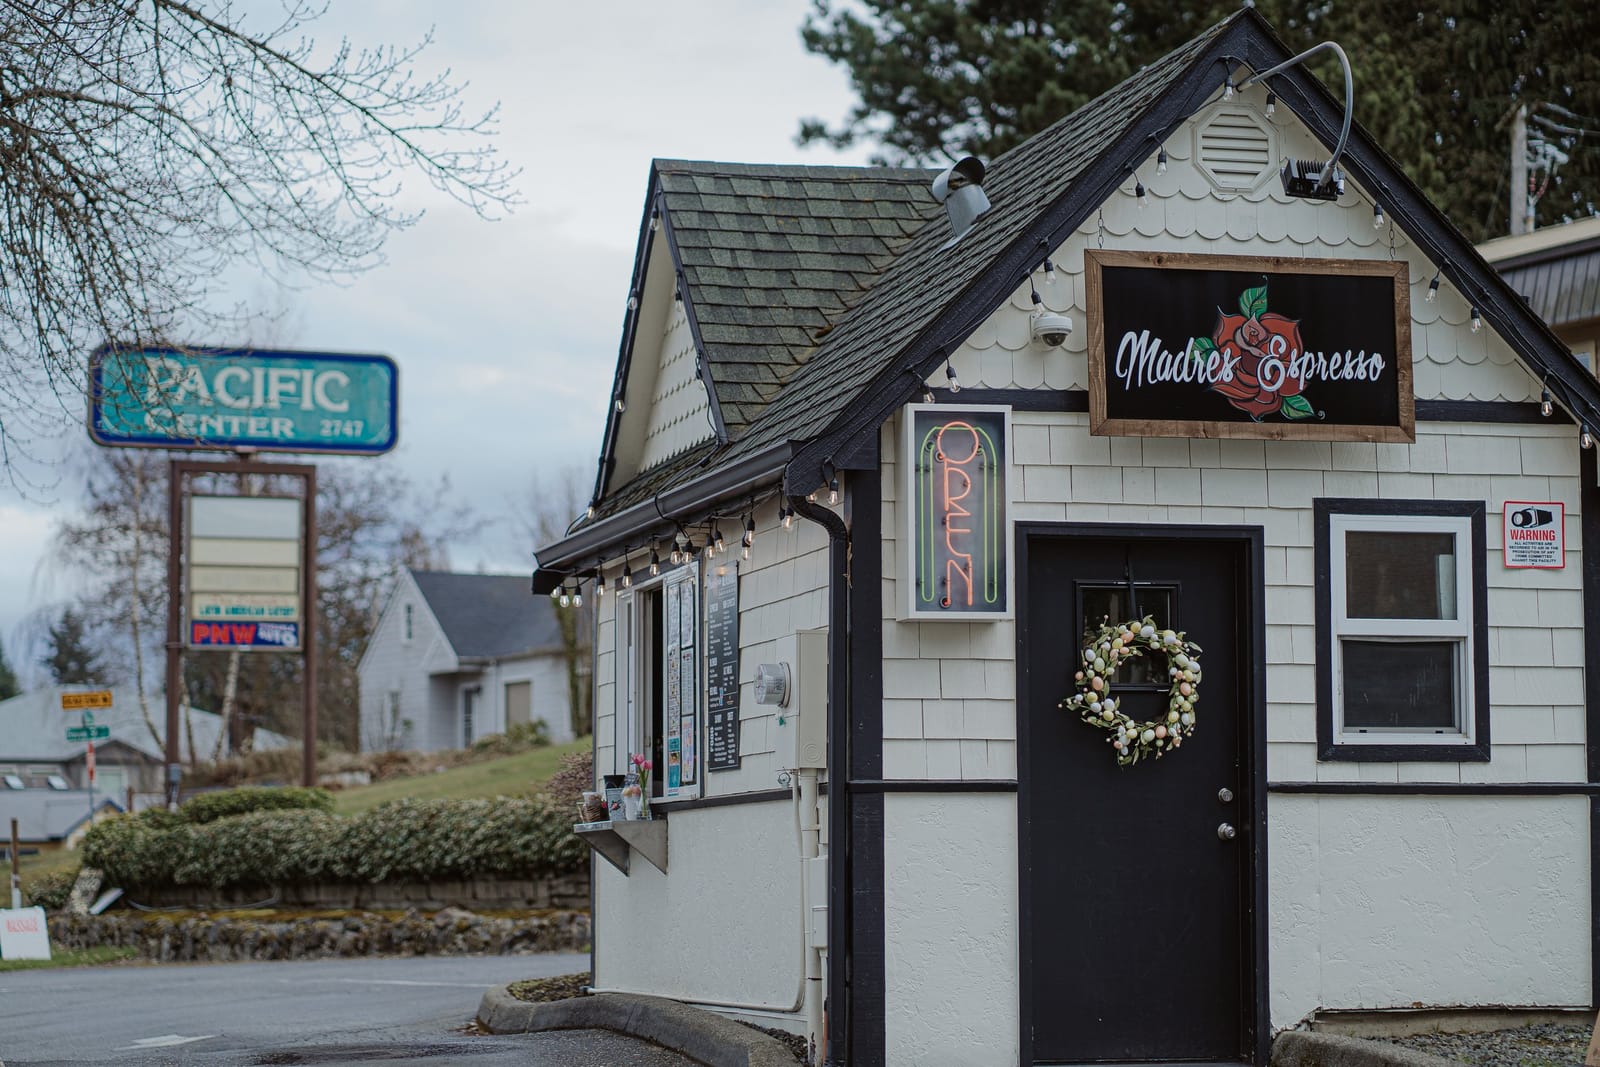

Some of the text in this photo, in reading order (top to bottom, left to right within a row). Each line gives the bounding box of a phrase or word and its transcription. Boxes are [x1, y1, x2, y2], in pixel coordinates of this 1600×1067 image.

[1115, 329, 1386, 392] Madres Espresso
[144, 356, 351, 413] PACIFIC
[144, 408, 295, 438] CENTER
[936, 420, 979, 606] OPEN
[1510, 529, 1556, 541] WARNING
[193, 623, 257, 645] PNW
